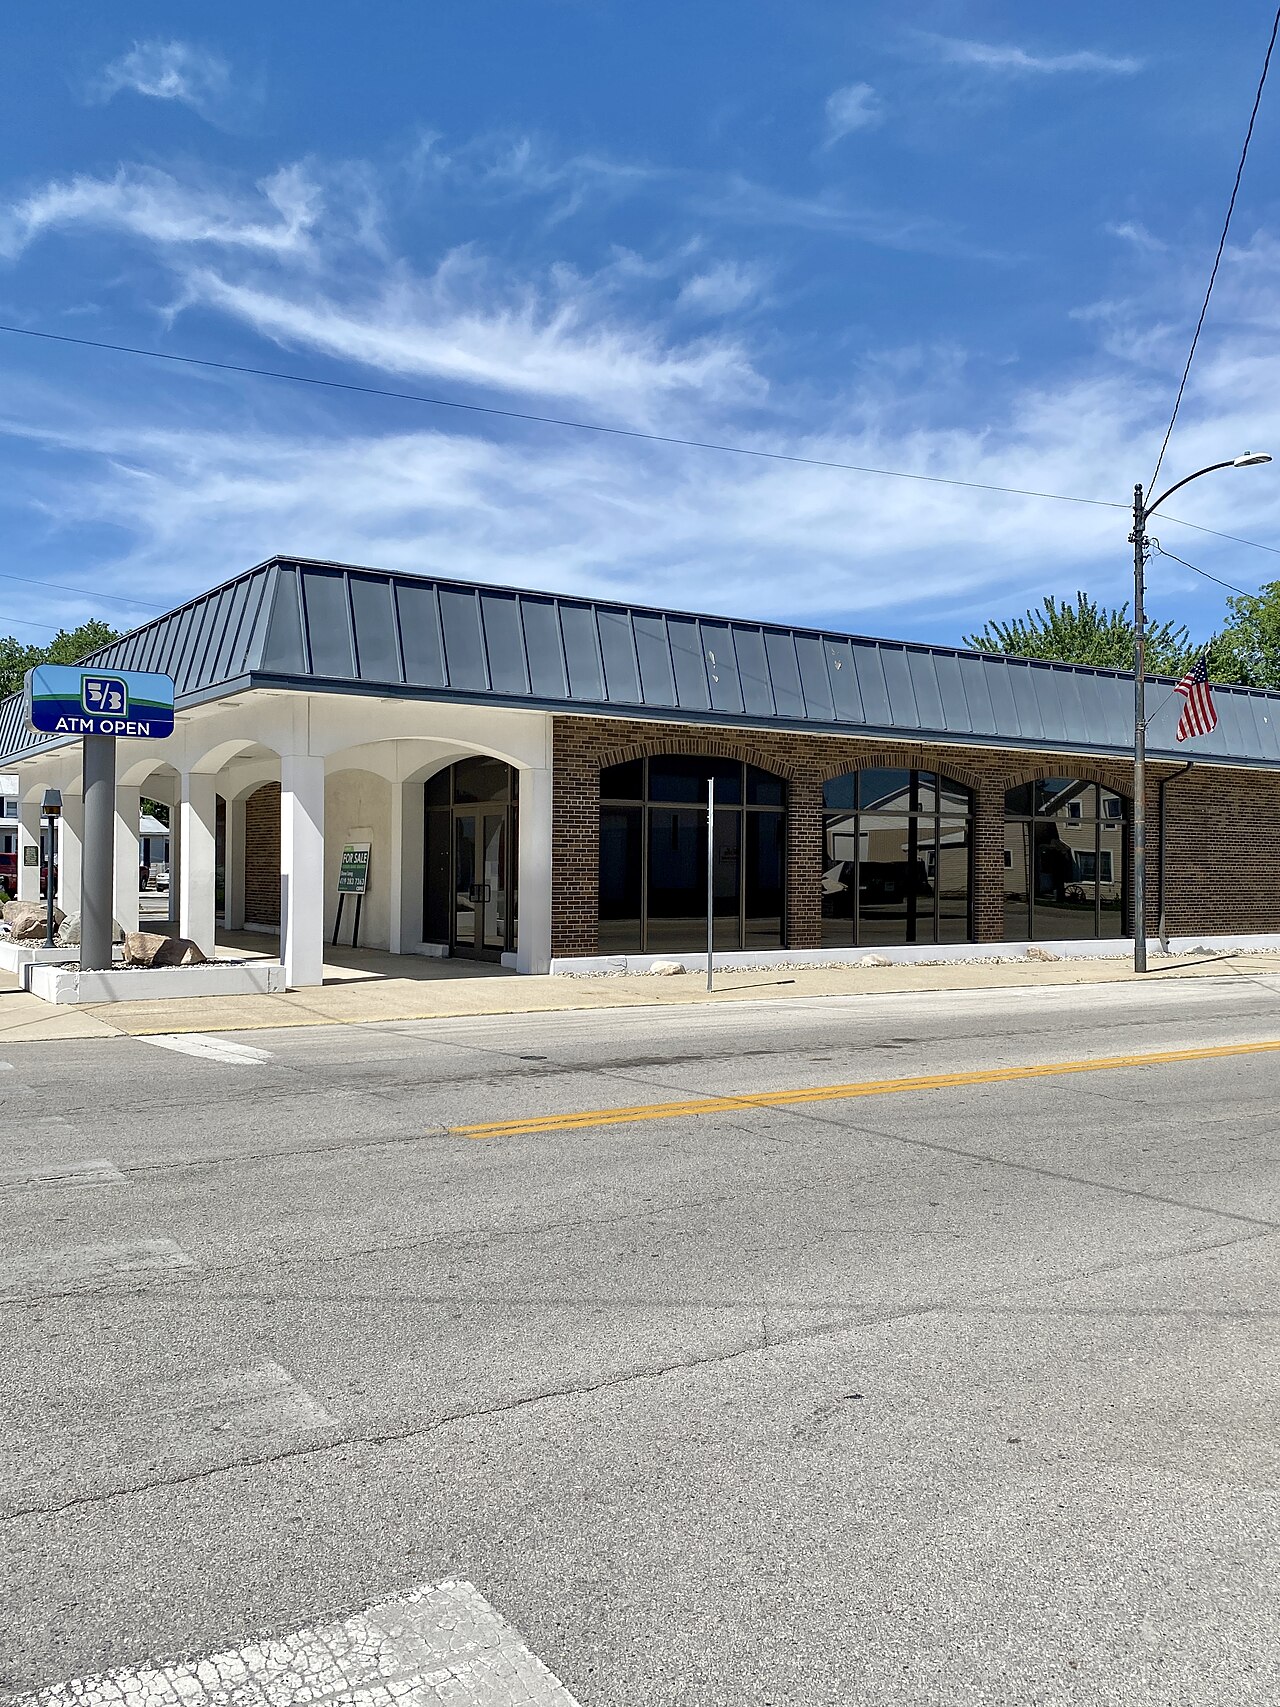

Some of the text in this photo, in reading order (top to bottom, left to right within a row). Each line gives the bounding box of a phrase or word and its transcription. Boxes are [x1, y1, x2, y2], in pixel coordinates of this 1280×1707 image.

[55, 717, 150, 736] ATM OPEN
[343, 853, 367, 863] FOR SALE
